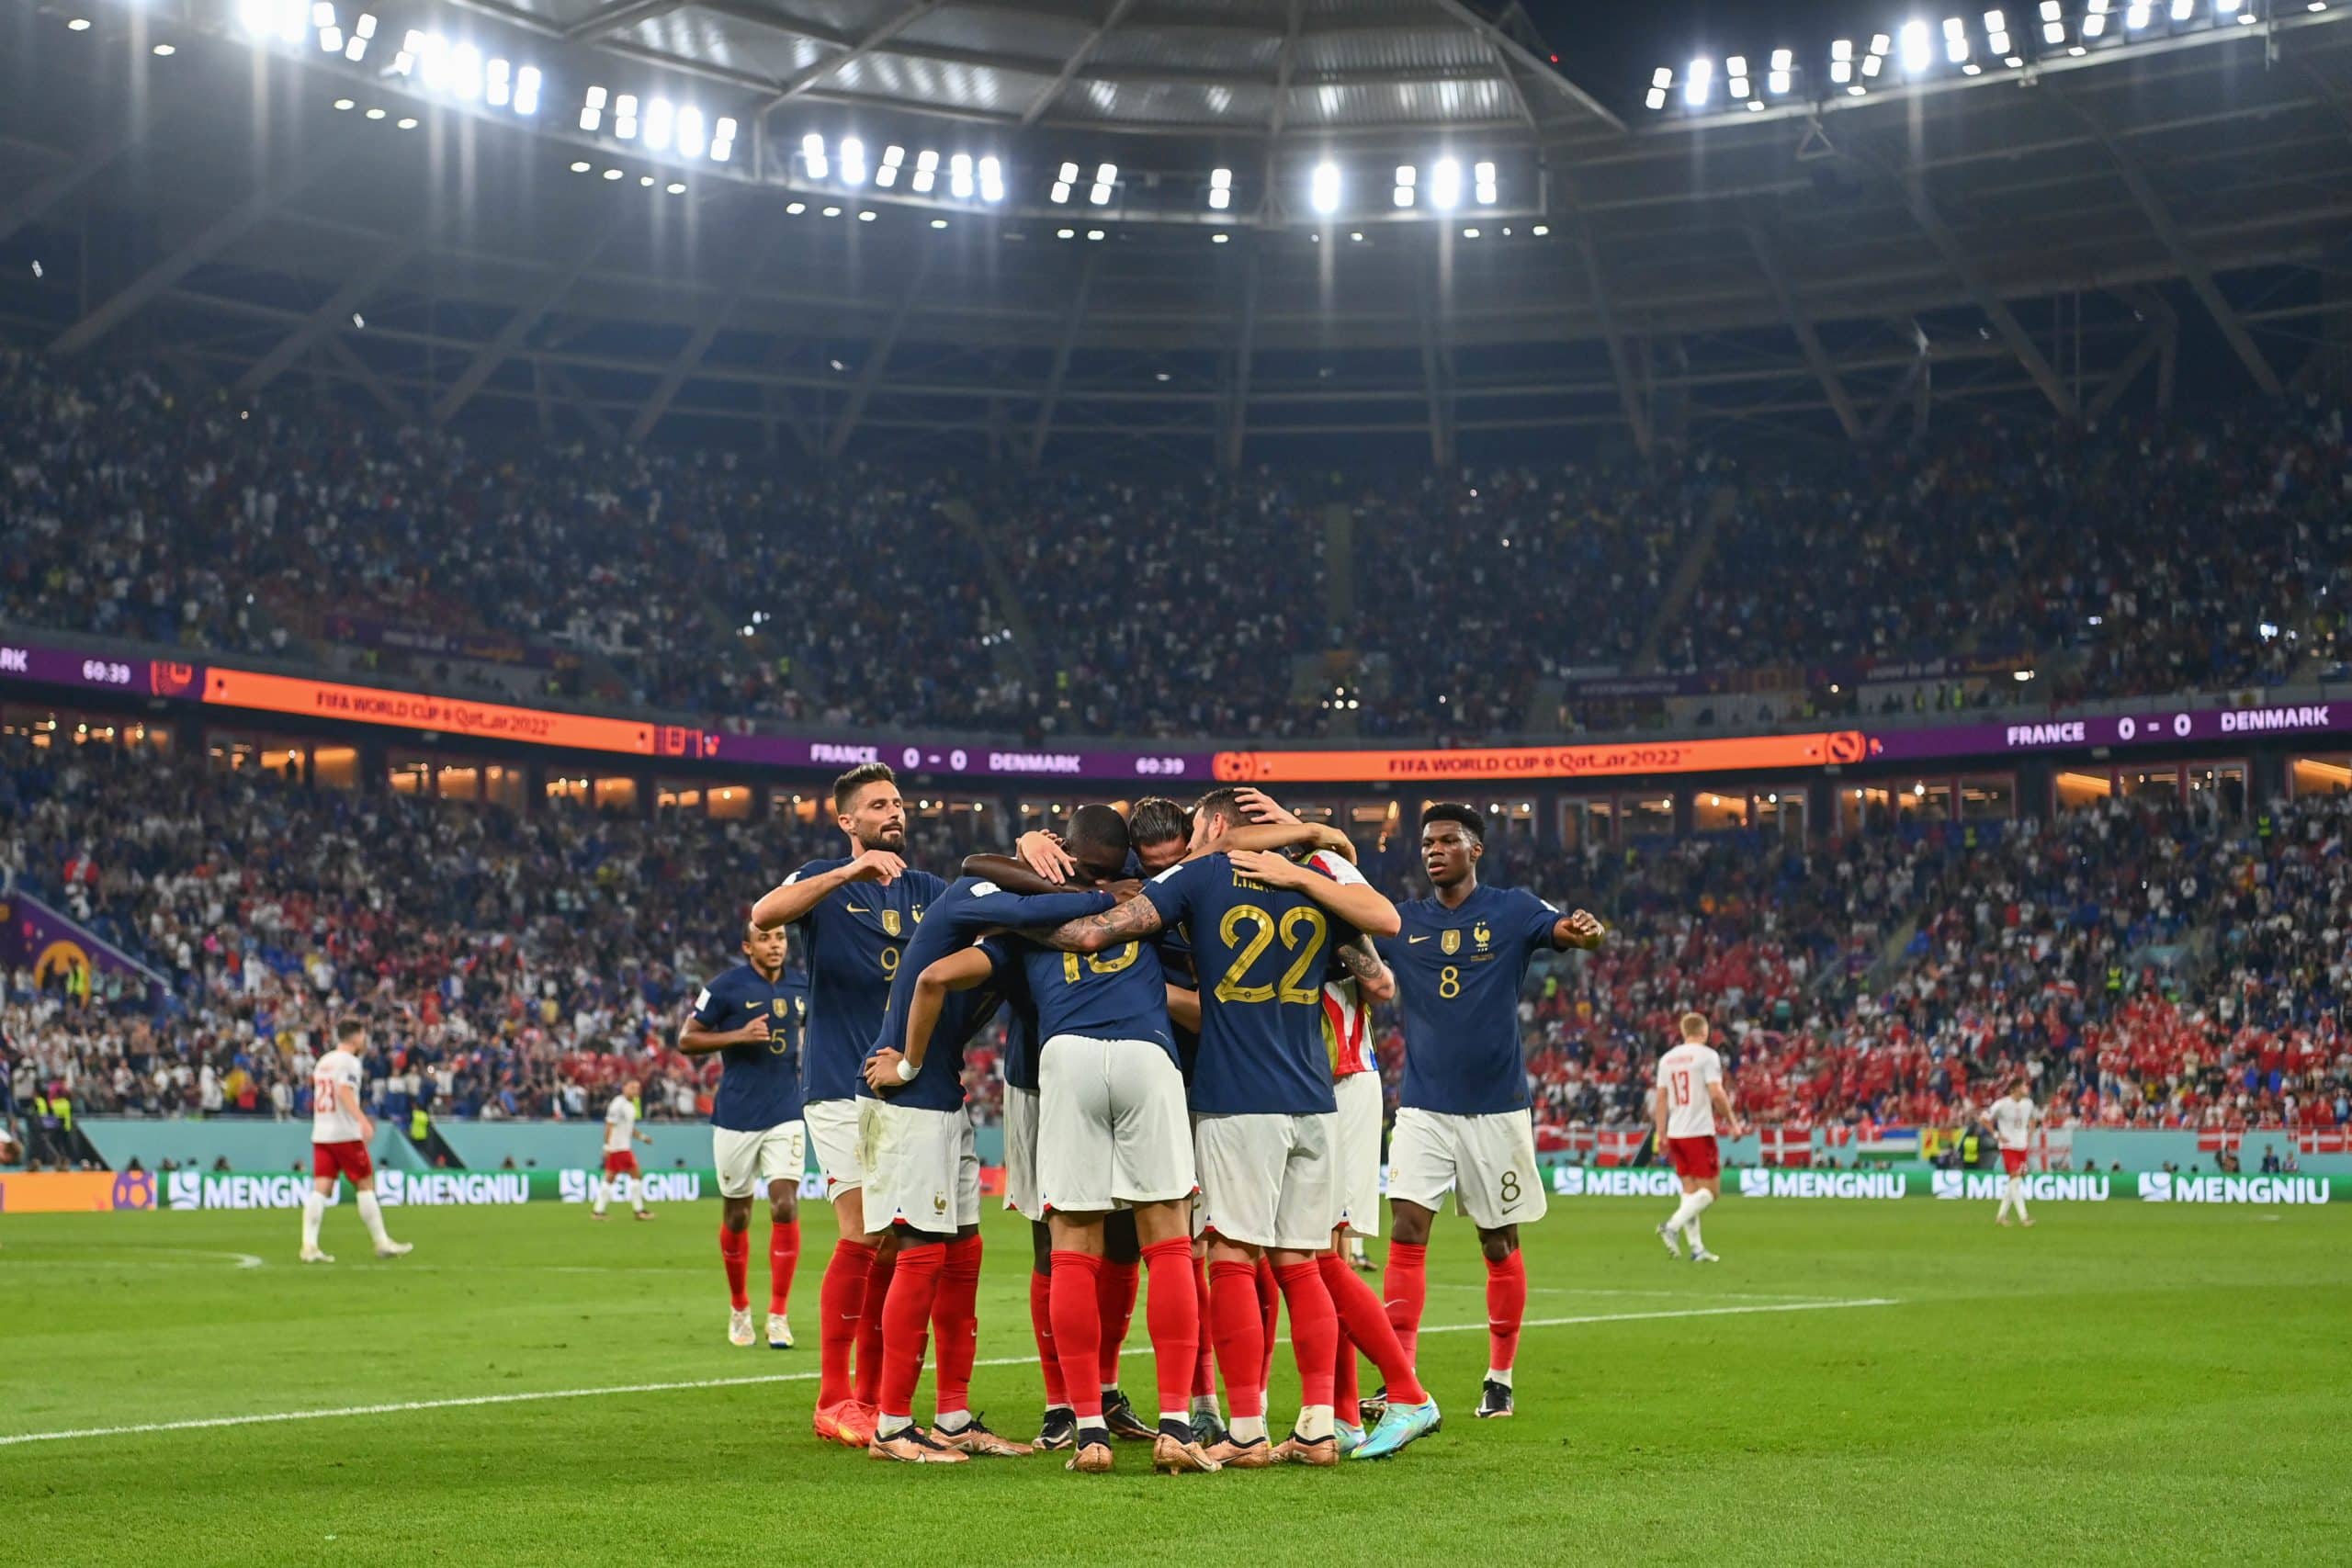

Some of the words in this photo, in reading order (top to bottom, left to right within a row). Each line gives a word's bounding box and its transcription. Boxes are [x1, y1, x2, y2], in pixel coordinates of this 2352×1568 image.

[83, 660, 130, 684] 60:39
[316, 691, 349, 708] FIFA
[354, 697, 409, 716] WORLD
[412, 702, 439, 720] CUP
[2007, 722, 2086, 746] FRANCE
[2118, 716, 2136, 739] 0
[2174, 713, 2192, 736] 0
[2221, 705, 2330, 732] DENMARK
[810, 743, 877, 763] FRANCE
[903, 747, 919, 769] 0
[950, 750, 967, 772] 0
[989, 752, 1081, 773] DENMARK
[1136, 757, 1185, 775] 60:39
[1389, 759, 1428, 773] FIFA
[1431, 757, 1499, 772] WORLD
[1504, 756, 1539, 771] CUP
[880, 946, 899, 981] 9
[1214, 904, 1328, 1005] 22
[1440, 965, 1460, 998] 8
[769, 1028, 787, 1055] 5
[1671, 1070, 1690, 1106] 13
[204, 1175, 341, 1209] MENGNU
[406, 1174, 529, 1205] MENGNIU
[1500, 1170, 1521, 1202] 8
[1587, 1170, 1684, 1197] MENGN
[1774, 1172, 1905, 1199] MENGNIU
[2176, 1176, 2330, 1205] MENGNIU
